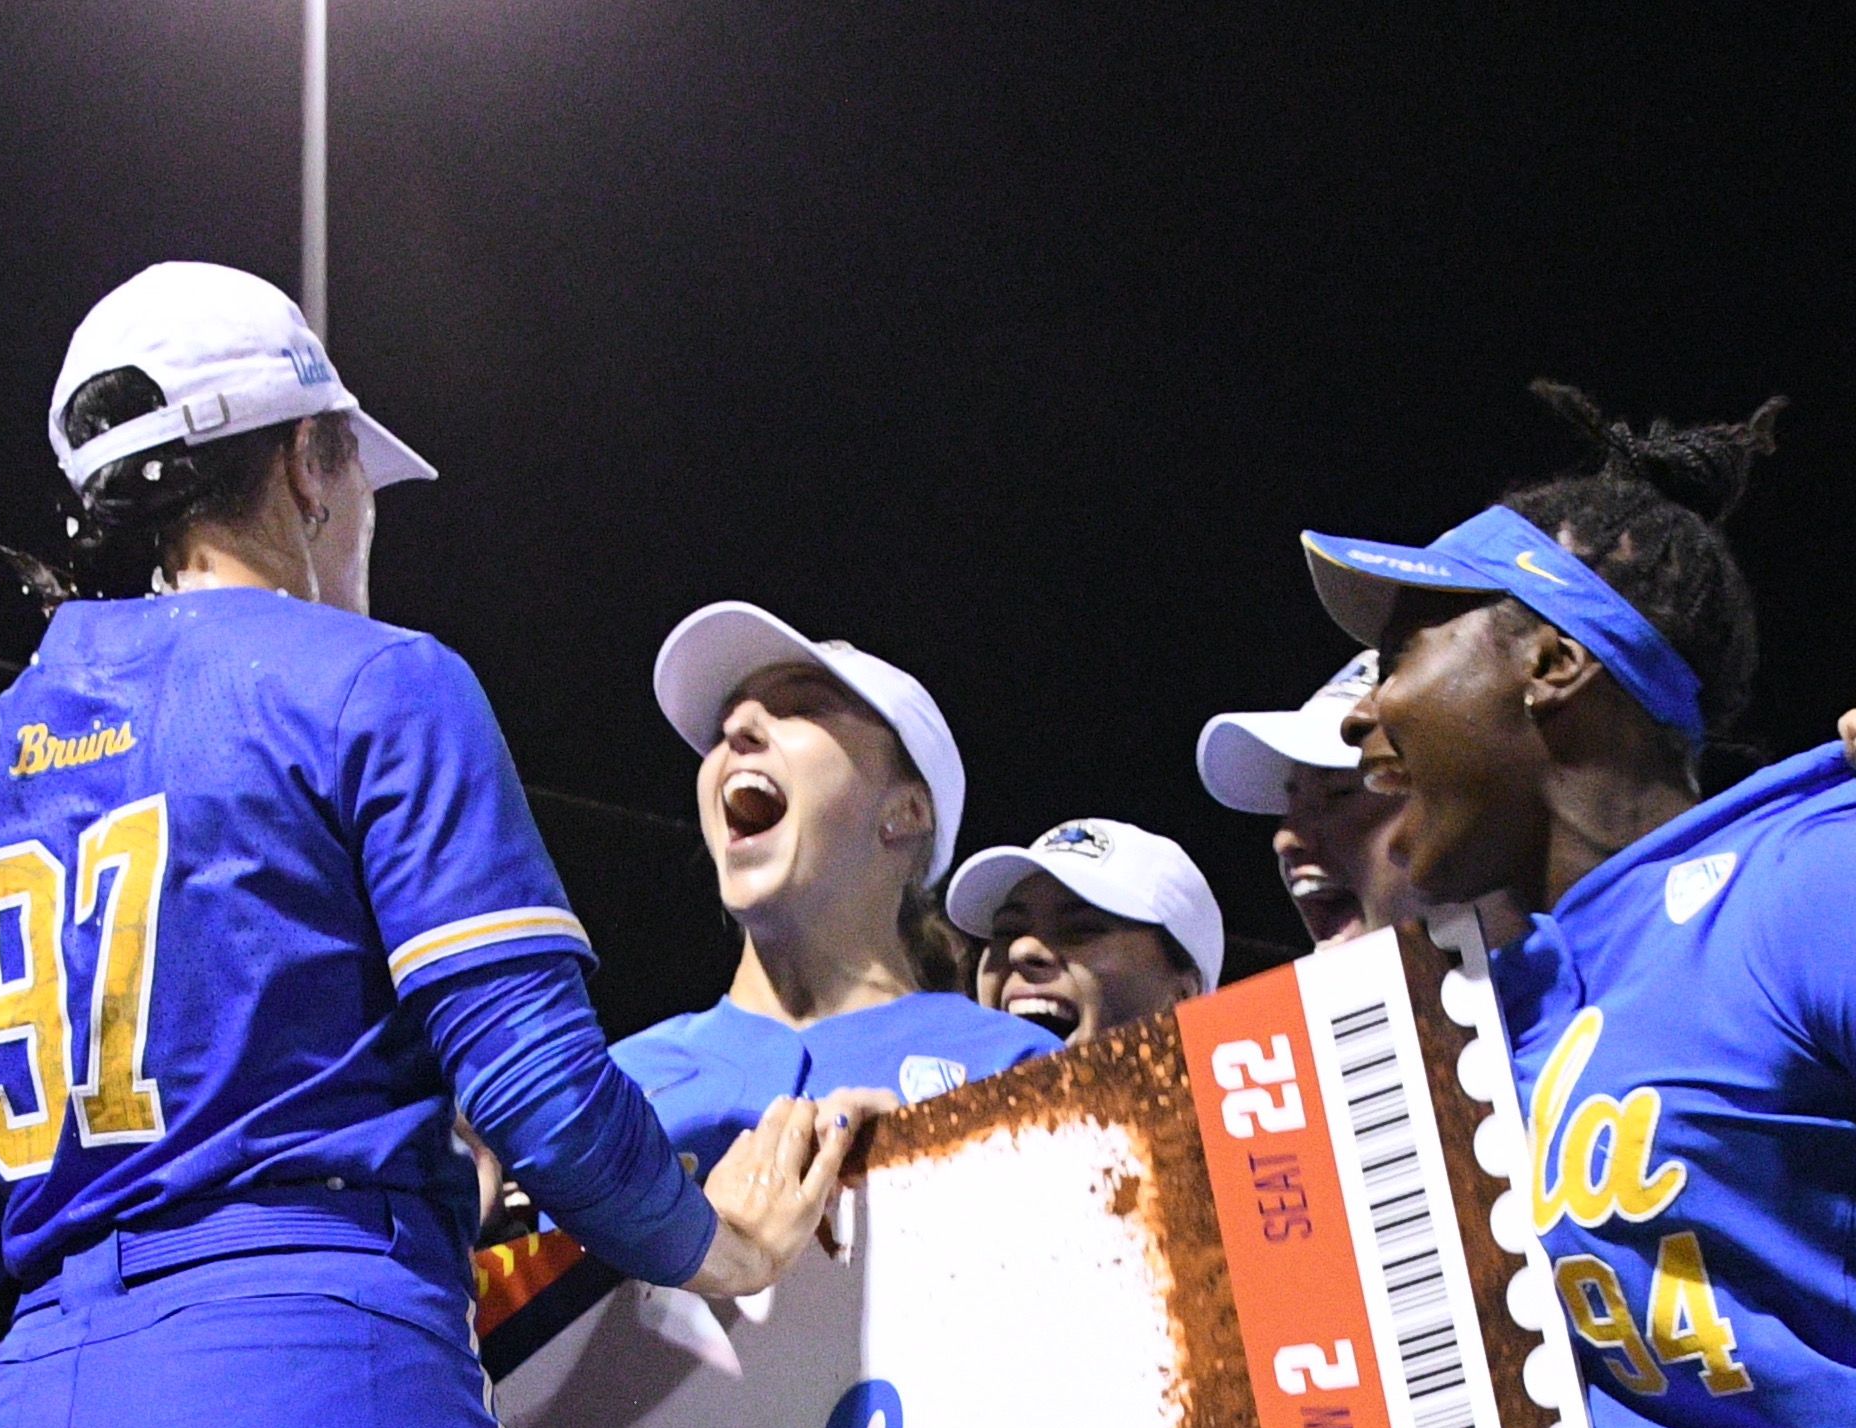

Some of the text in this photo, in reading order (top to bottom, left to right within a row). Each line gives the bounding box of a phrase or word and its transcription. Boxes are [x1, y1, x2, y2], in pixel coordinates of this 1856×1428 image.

[1347, 549, 1452, 577] SOFTBALL
[9, 720, 138, 776] Bruins
[1210, 1033, 1308, 1139] 22
[1529, 1005, 1688, 1236] la
[1248, 1152, 1313, 1246] SEAT
[1553, 1231, 1754, 1397] 94
[1273, 1338, 1360, 1395] 2
